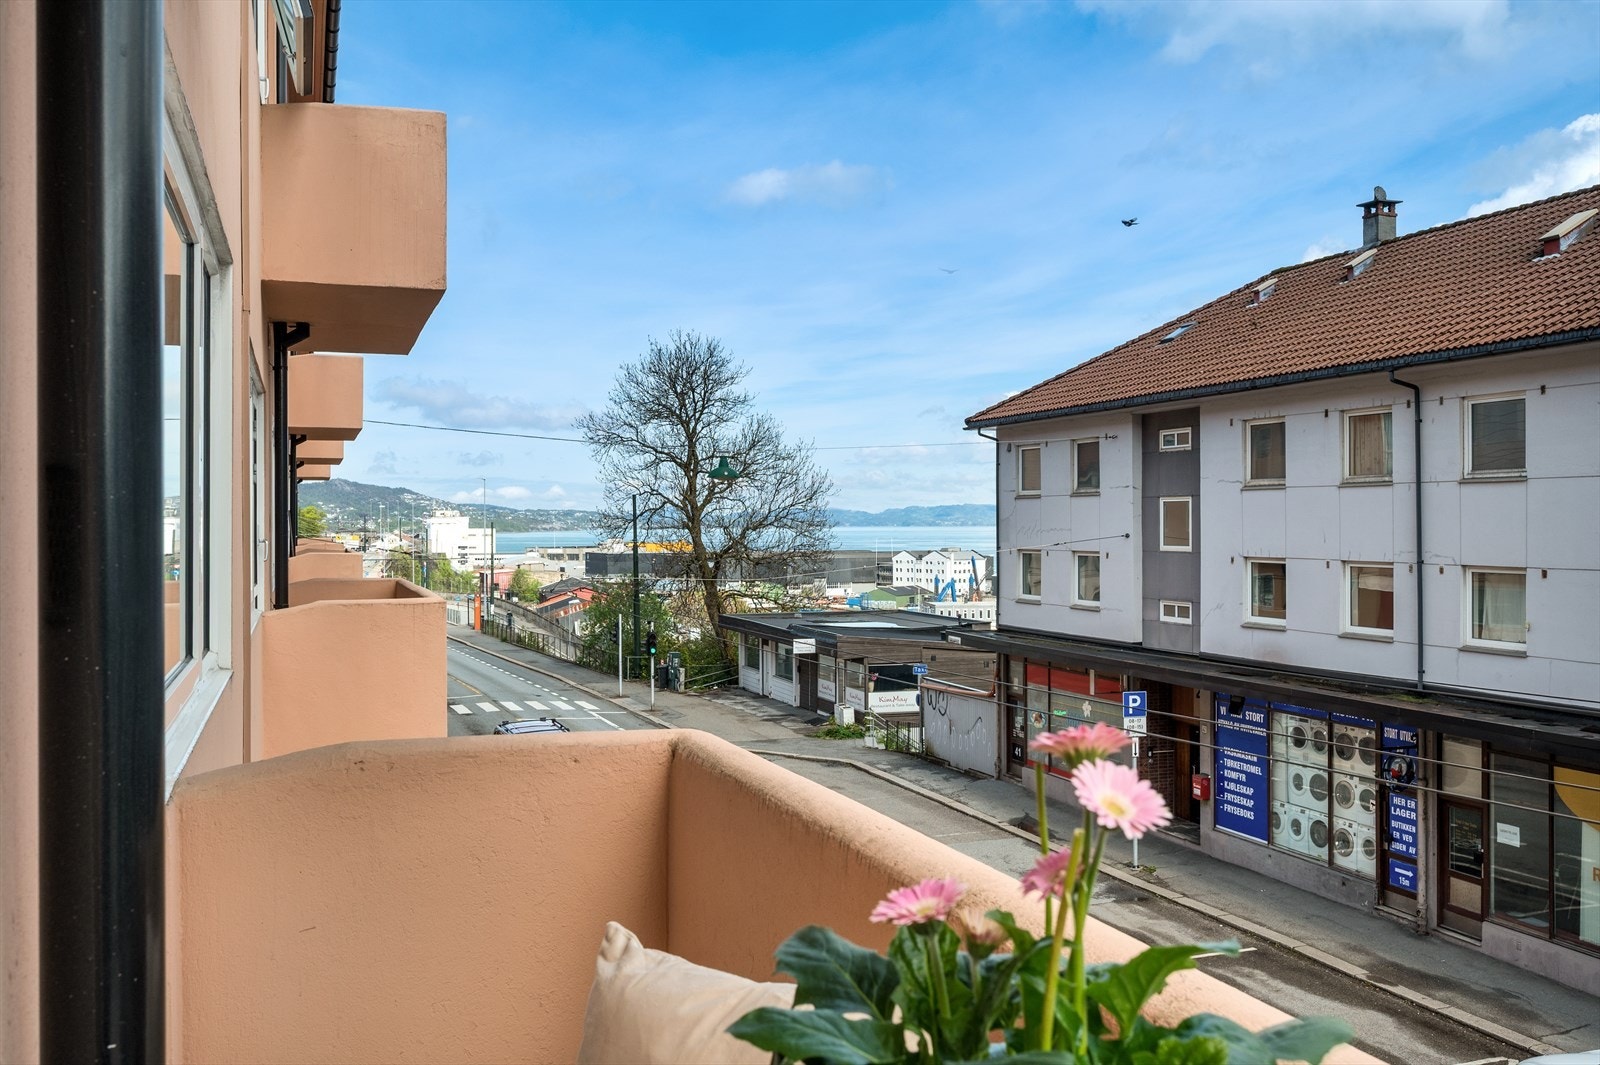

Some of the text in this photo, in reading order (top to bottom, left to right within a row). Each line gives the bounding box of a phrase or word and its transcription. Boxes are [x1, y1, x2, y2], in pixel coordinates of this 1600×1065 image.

[1128, 695, 1141, 714] P
[1220, 705, 1227, 716] VI
[1245, 710, 1265, 724] STORT
[1384, 726, 1398, 740] STORT
[1014, 747, 1022, 757] 41
[1224, 768, 1247, 782] KOMFYR
[1224, 792, 1255, 808] FRYSESKAP
[1393, 796, 1416, 810] HER ER
[1223, 803, 1255, 820] FRYSEBOKS
[1391, 806, 1417, 821] LAGER
[1391, 820, 1416, 834] BUTIKKEN
[1393, 831, 1413, 843] ER VED
[1391, 841, 1417, 855] SIDEN AV
[1399, 876, 1410, 887] 15m
